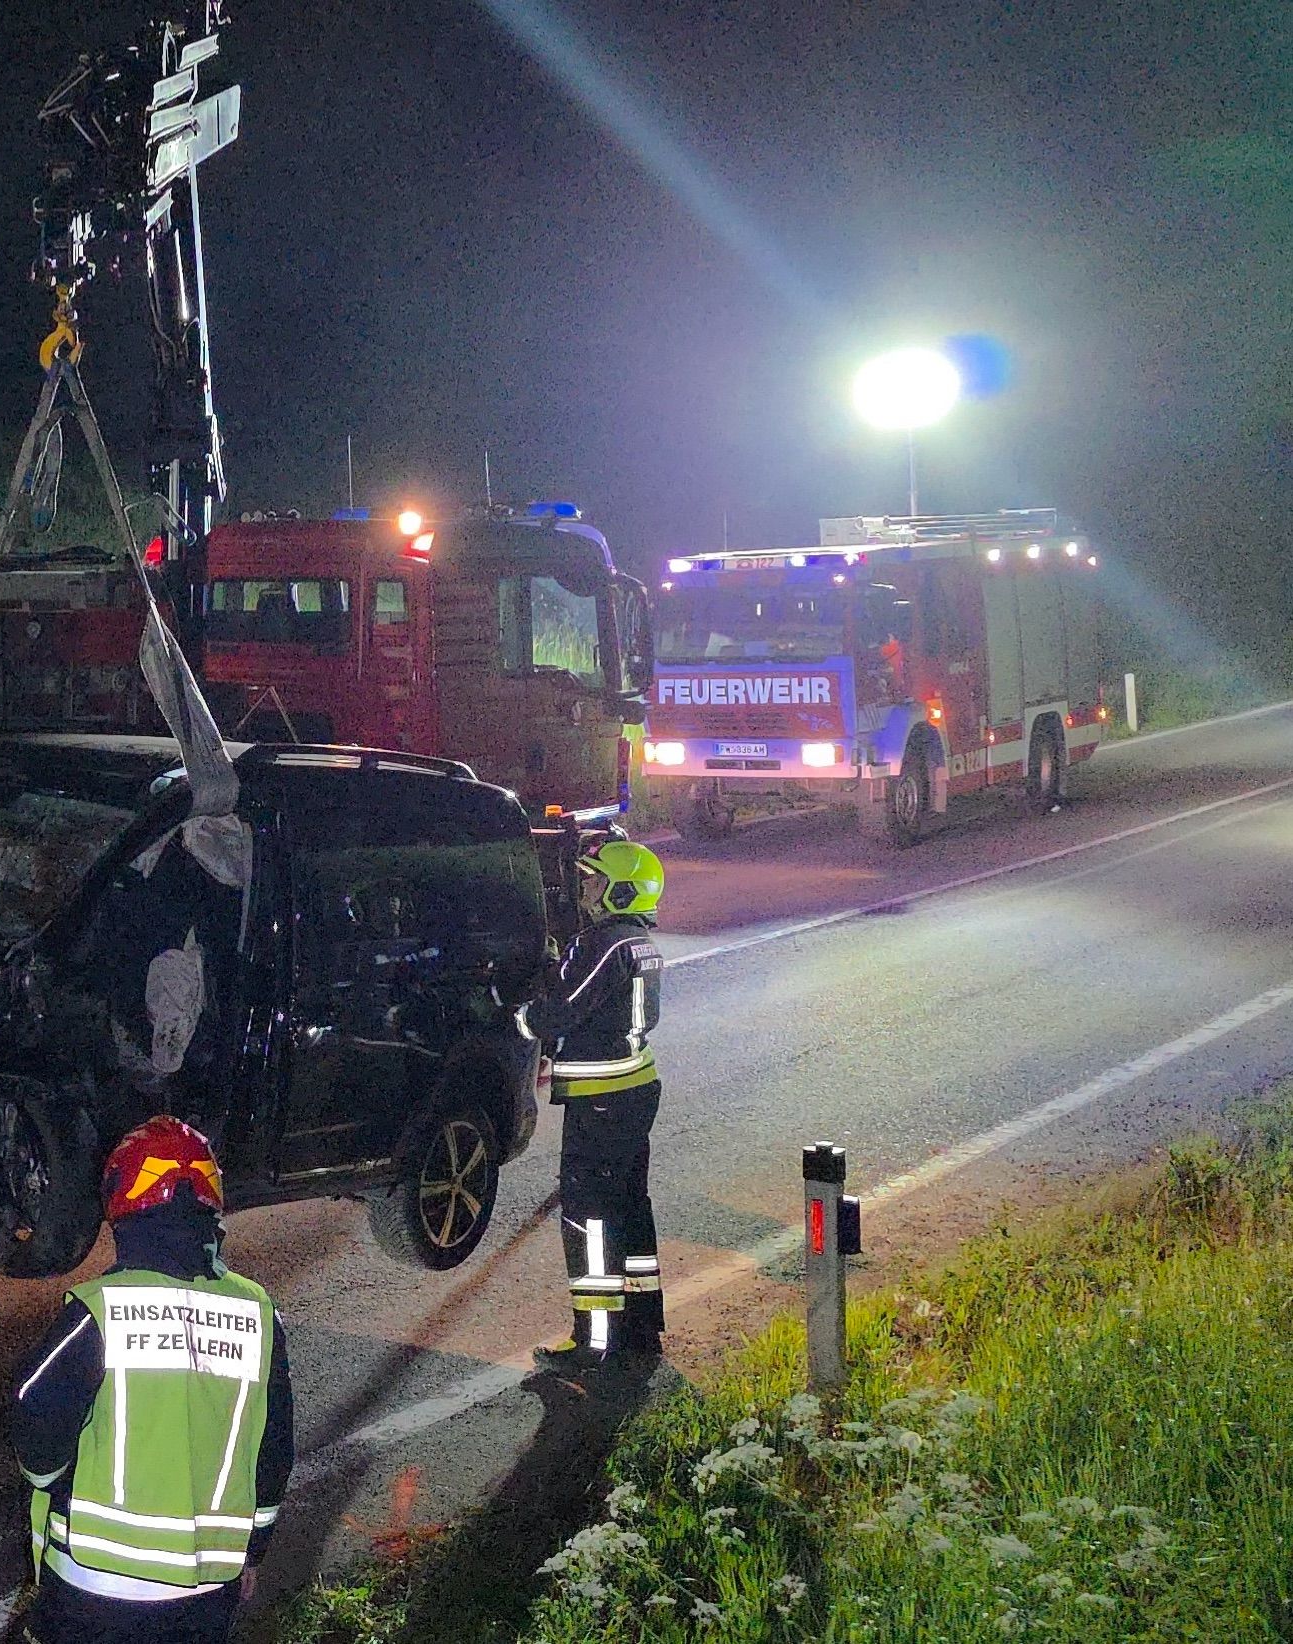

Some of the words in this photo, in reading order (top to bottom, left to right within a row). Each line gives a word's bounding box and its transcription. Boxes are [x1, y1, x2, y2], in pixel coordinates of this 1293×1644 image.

[658, 677, 831, 705] FEUERWEHR
[109, 1304, 258, 1334] EINSATZLEITER
[126, 1333, 151, 1350] FF
